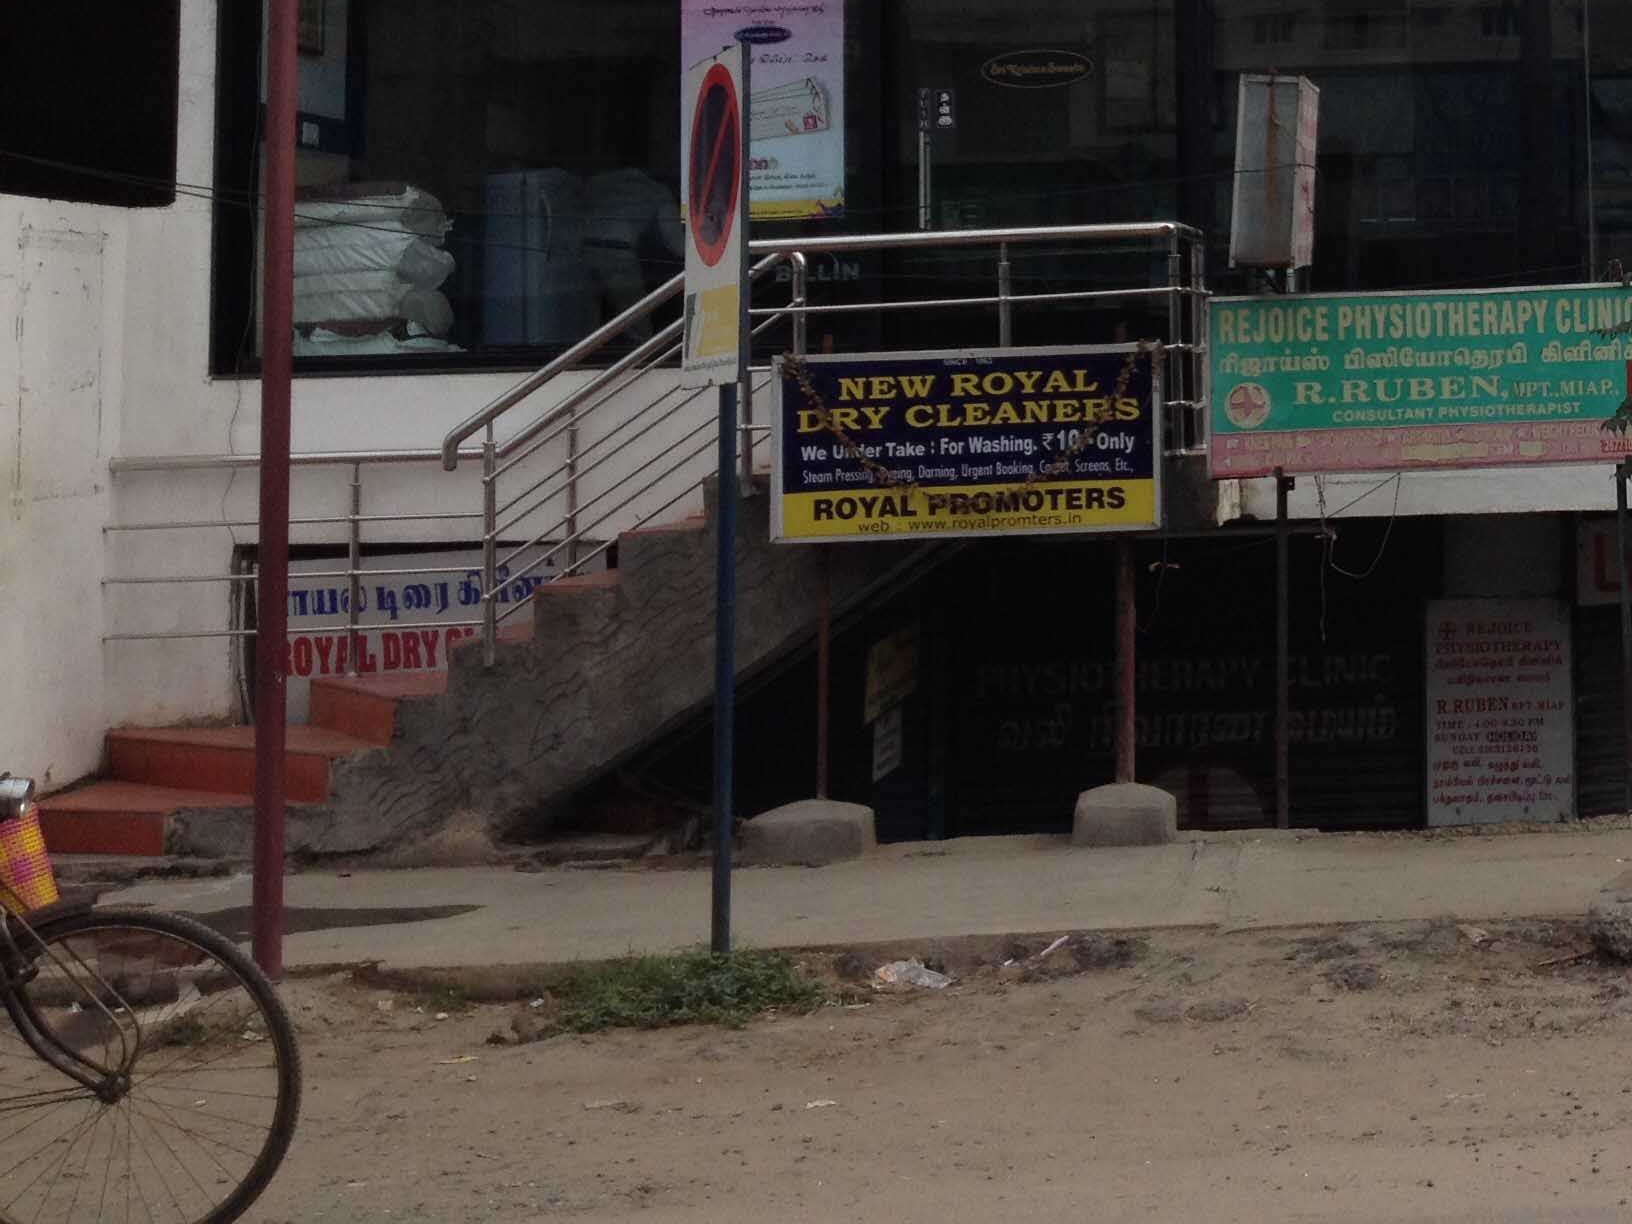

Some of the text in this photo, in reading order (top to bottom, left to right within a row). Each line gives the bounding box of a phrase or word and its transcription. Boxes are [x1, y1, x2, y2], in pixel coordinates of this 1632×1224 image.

[1218, 307, 1329, 345] REJOICE
[1337, 299, 1549, 340] PHYSIOTHERAPY
[838, 368, 1099, 403] NEW ROYAL
[797, 397, 1141, 434] DRY CLEANERS
[1332, 401, 1582, 423] CONSULTANT PHYSIOTHERAPIST
[801, 445, 827, 462] We
[885, 442, 926, 457] Take
[940, 438, 965, 454] For
[968, 434, 1038, 456] Washing.
[1096, 431, 1136, 454] Only
[803, 469, 833, 484] Steam
[961, 462, 993, 480] Urgent
[813, 486, 1126, 521] ROYAL PROMOTERS
[858, 520, 890, 533] web
[381, 629, 439, 670] DRY
